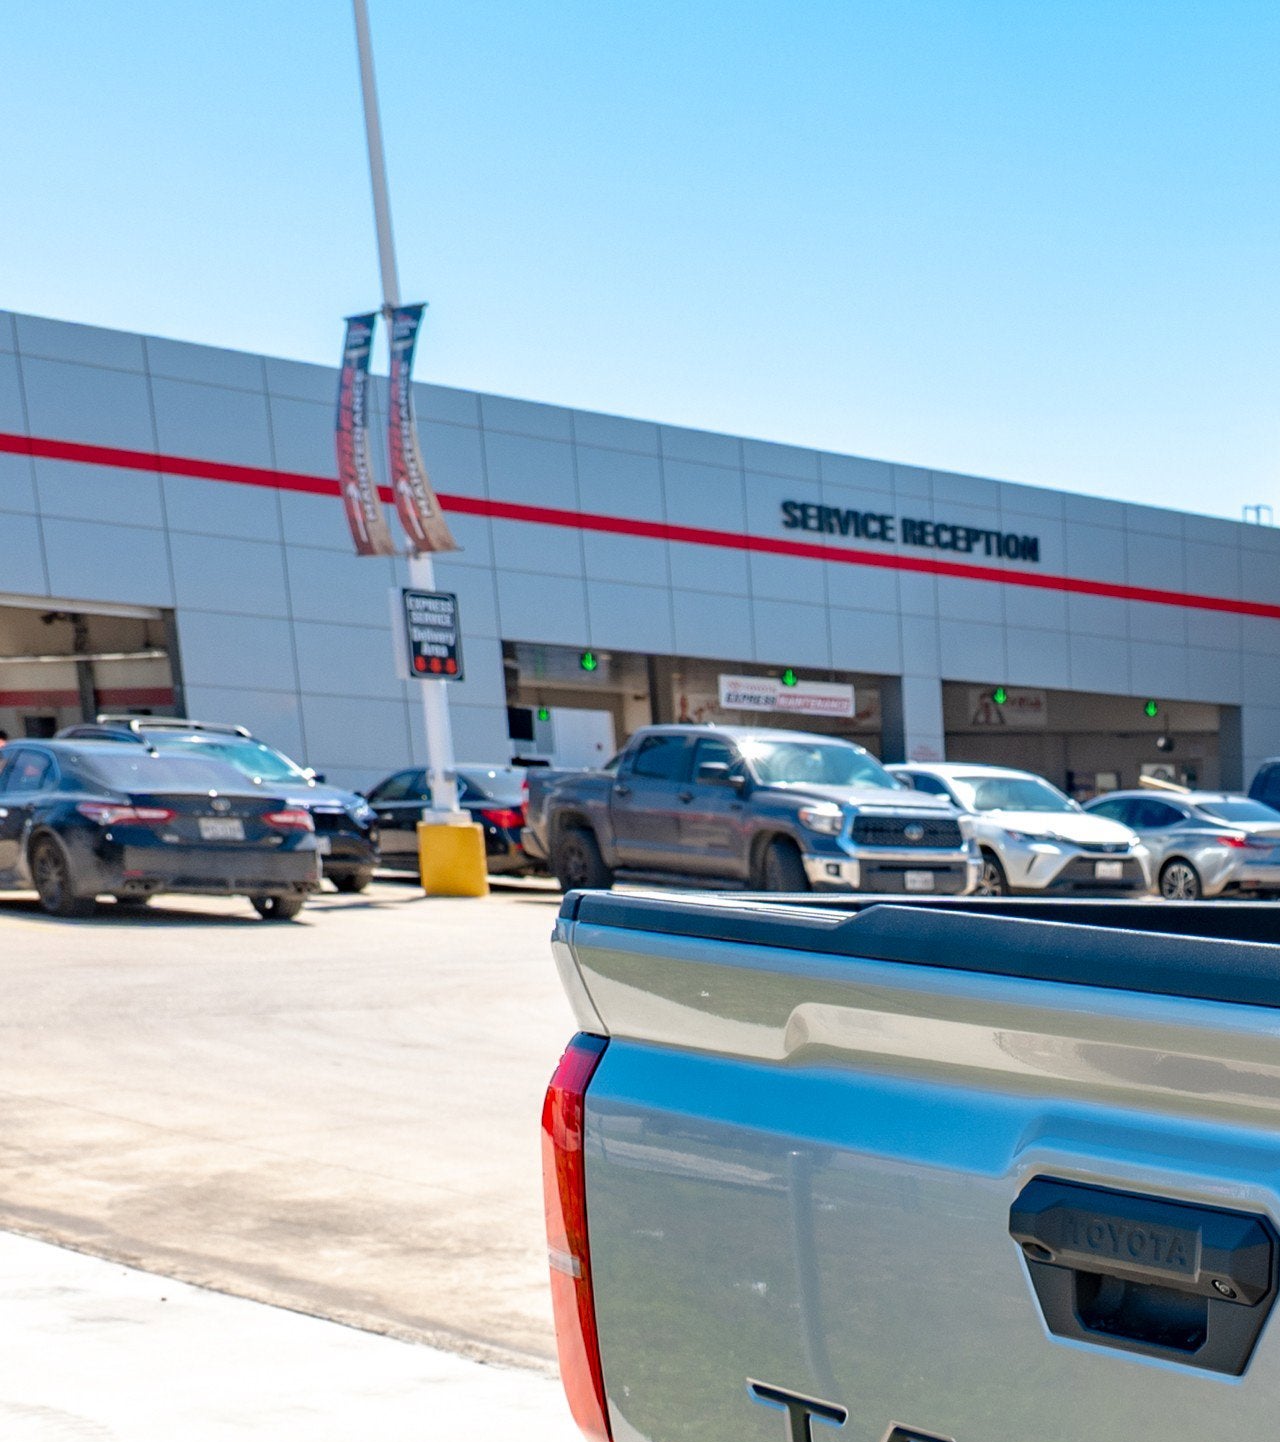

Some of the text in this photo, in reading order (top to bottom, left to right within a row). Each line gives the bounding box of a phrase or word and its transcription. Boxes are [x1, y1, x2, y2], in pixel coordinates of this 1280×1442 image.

[781, 500, 1040, 563] SERVICE RECEPTION
[1062, 1215, 1188, 1268] TOYOTA
